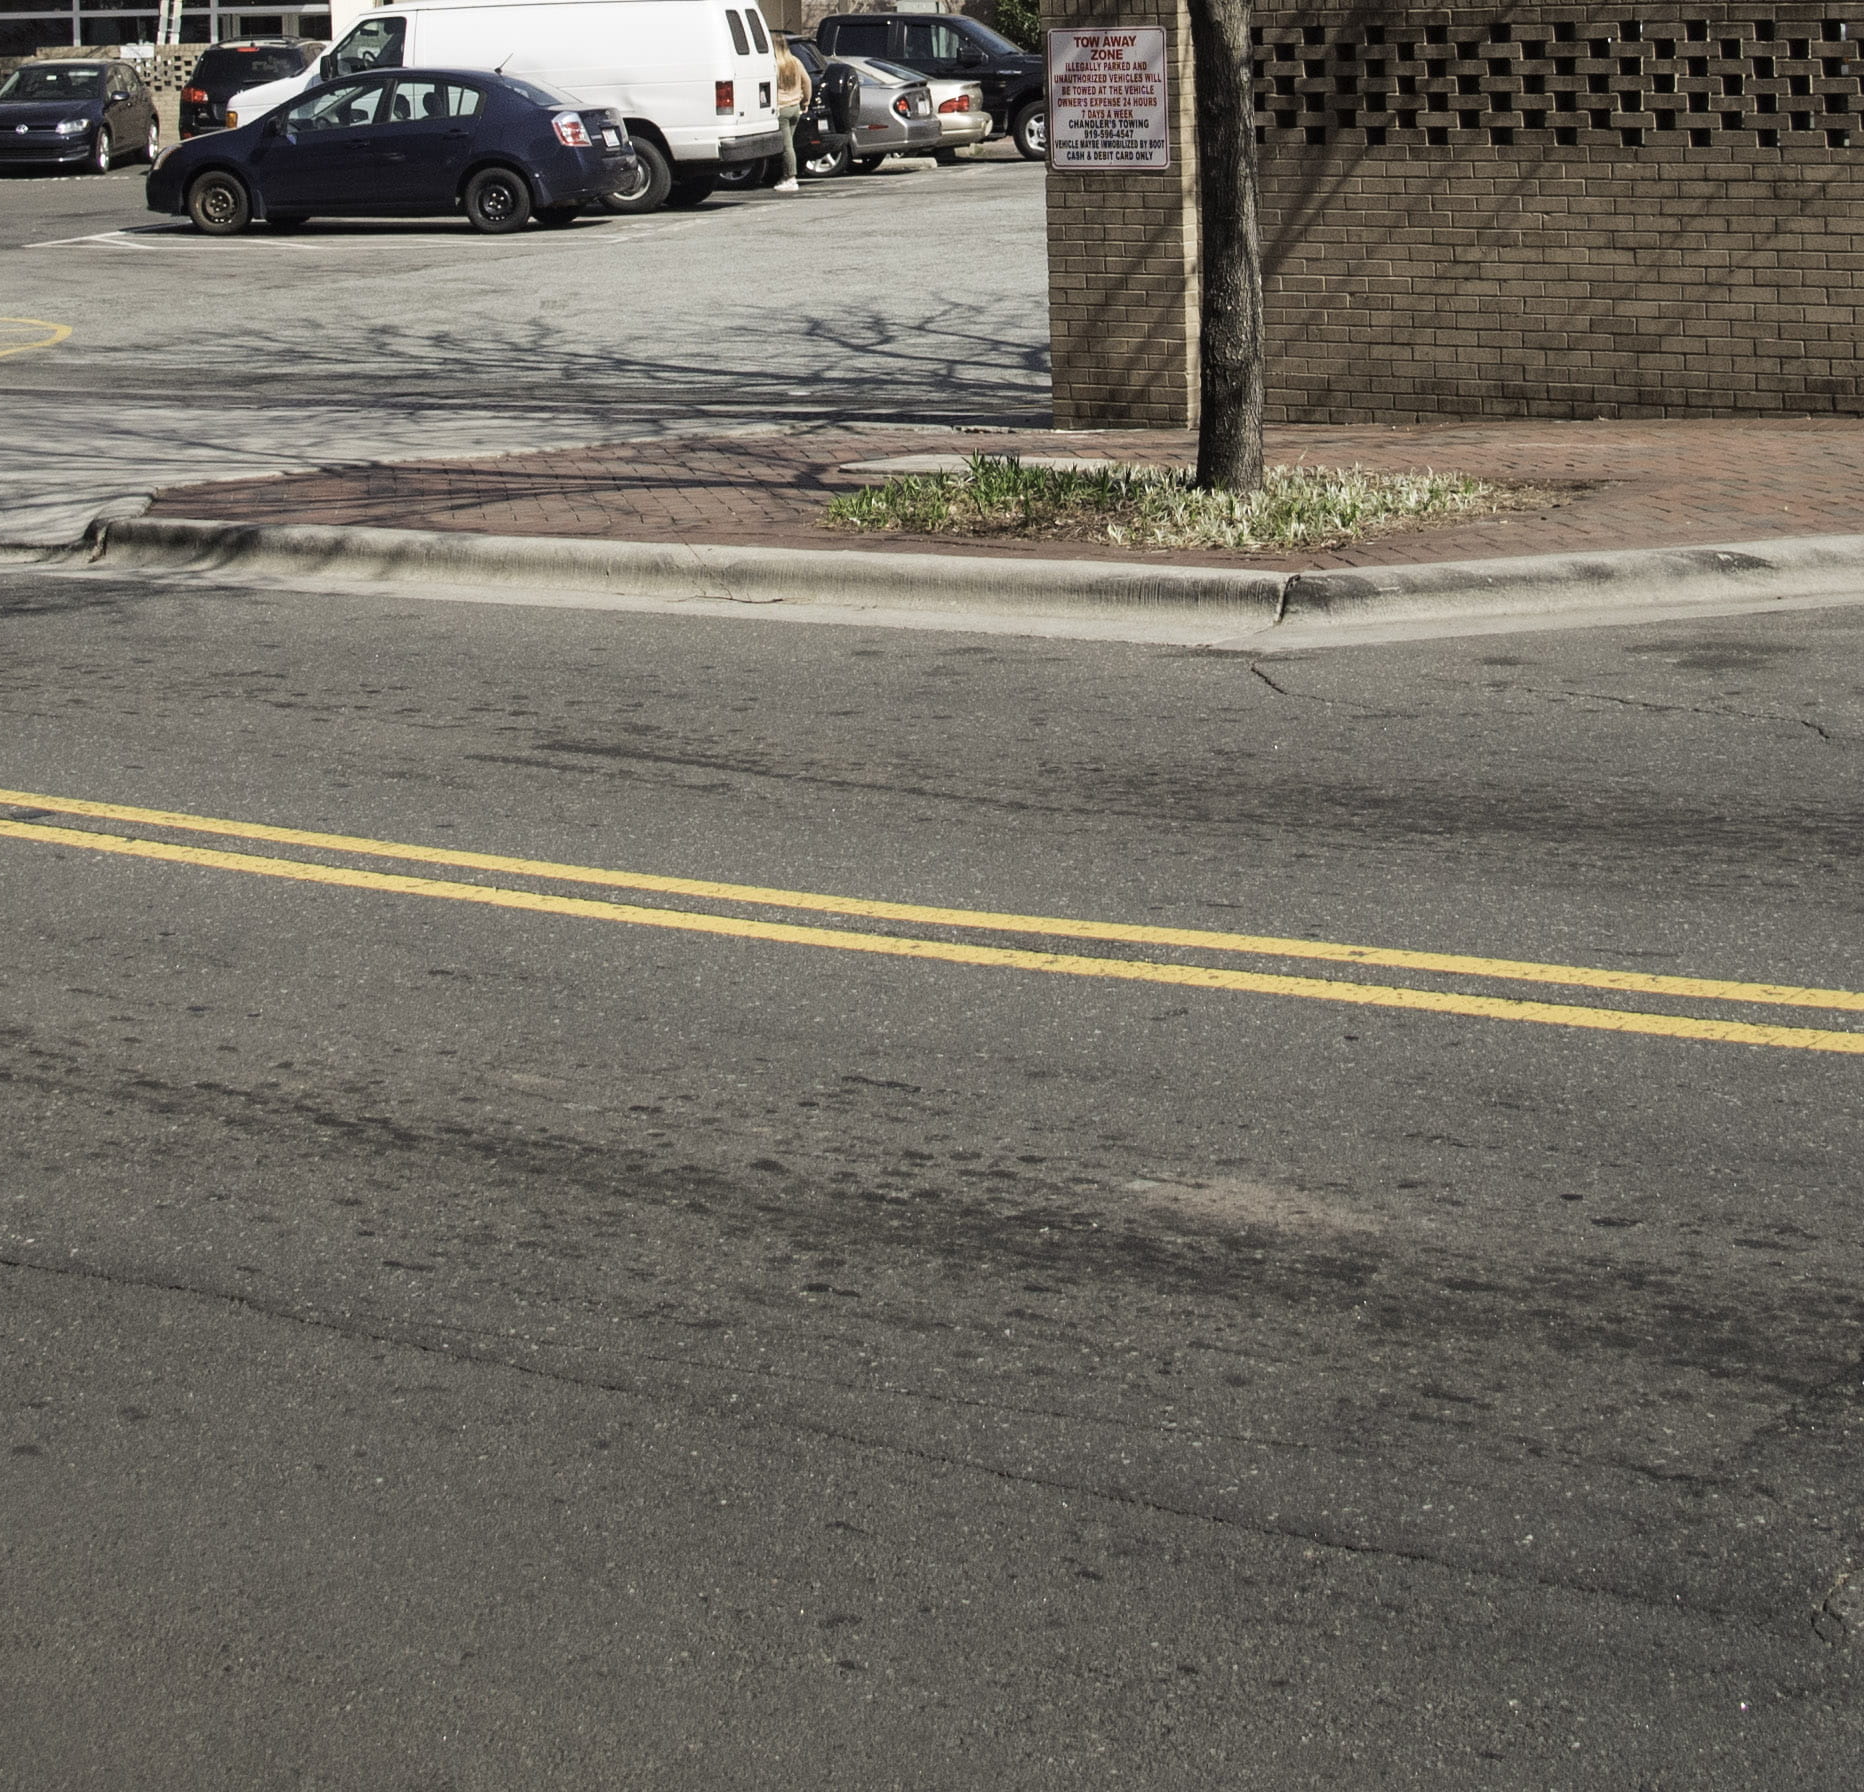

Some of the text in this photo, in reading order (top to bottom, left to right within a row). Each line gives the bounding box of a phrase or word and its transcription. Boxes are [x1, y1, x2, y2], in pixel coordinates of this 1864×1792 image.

[1073, 35, 1137, 48] TOW AWAY
[1090, 49, 1124, 61] ZONE
[1065, 61, 1147, 72] ILLEGALLY PARKED AND
[1054, 73, 1162, 84] UNAUTHORIZED VEHICLES WILL
[1061, 85, 1155, 95] BE TOWED AT THE VEHICLE
[1057, 97, 1158, 107] OWNER'S EXPENSE 24 HOURS
[1081, 109, 1134, 119] 7 DAYS A WEEK
[1068, 119, 1150, 129] CHANDLER'S TOWING
[1066, 151, 1154, 161] CASH & DEBIT CARD ONLY
